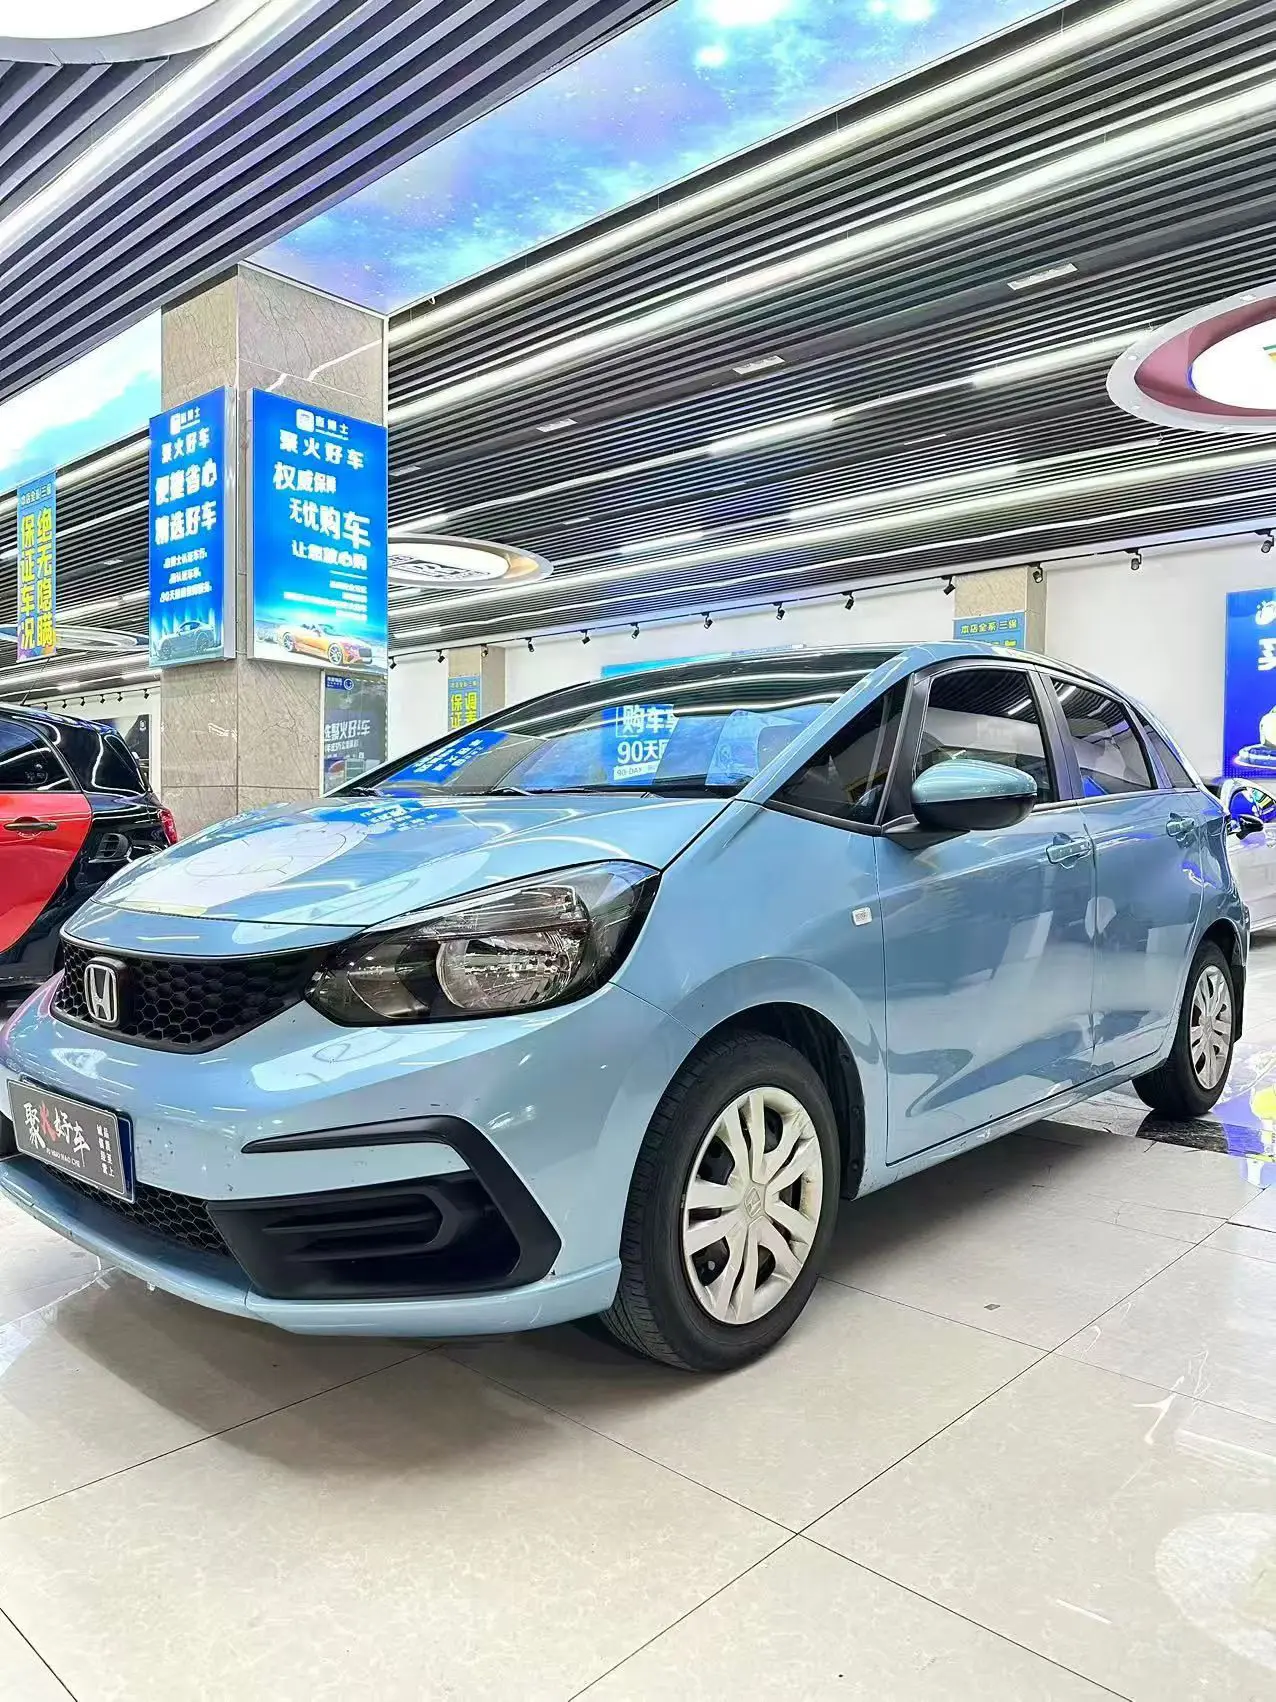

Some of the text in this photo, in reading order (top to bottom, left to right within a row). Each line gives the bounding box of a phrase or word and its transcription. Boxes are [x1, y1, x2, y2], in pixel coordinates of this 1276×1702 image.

[280, 429, 365, 470] 聚火好车
[20, 514, 36, 651] 保证车况
[37, 507, 55, 648] 绝无隐瞒
[24, 1100, 91, 1168] 聚火好车
